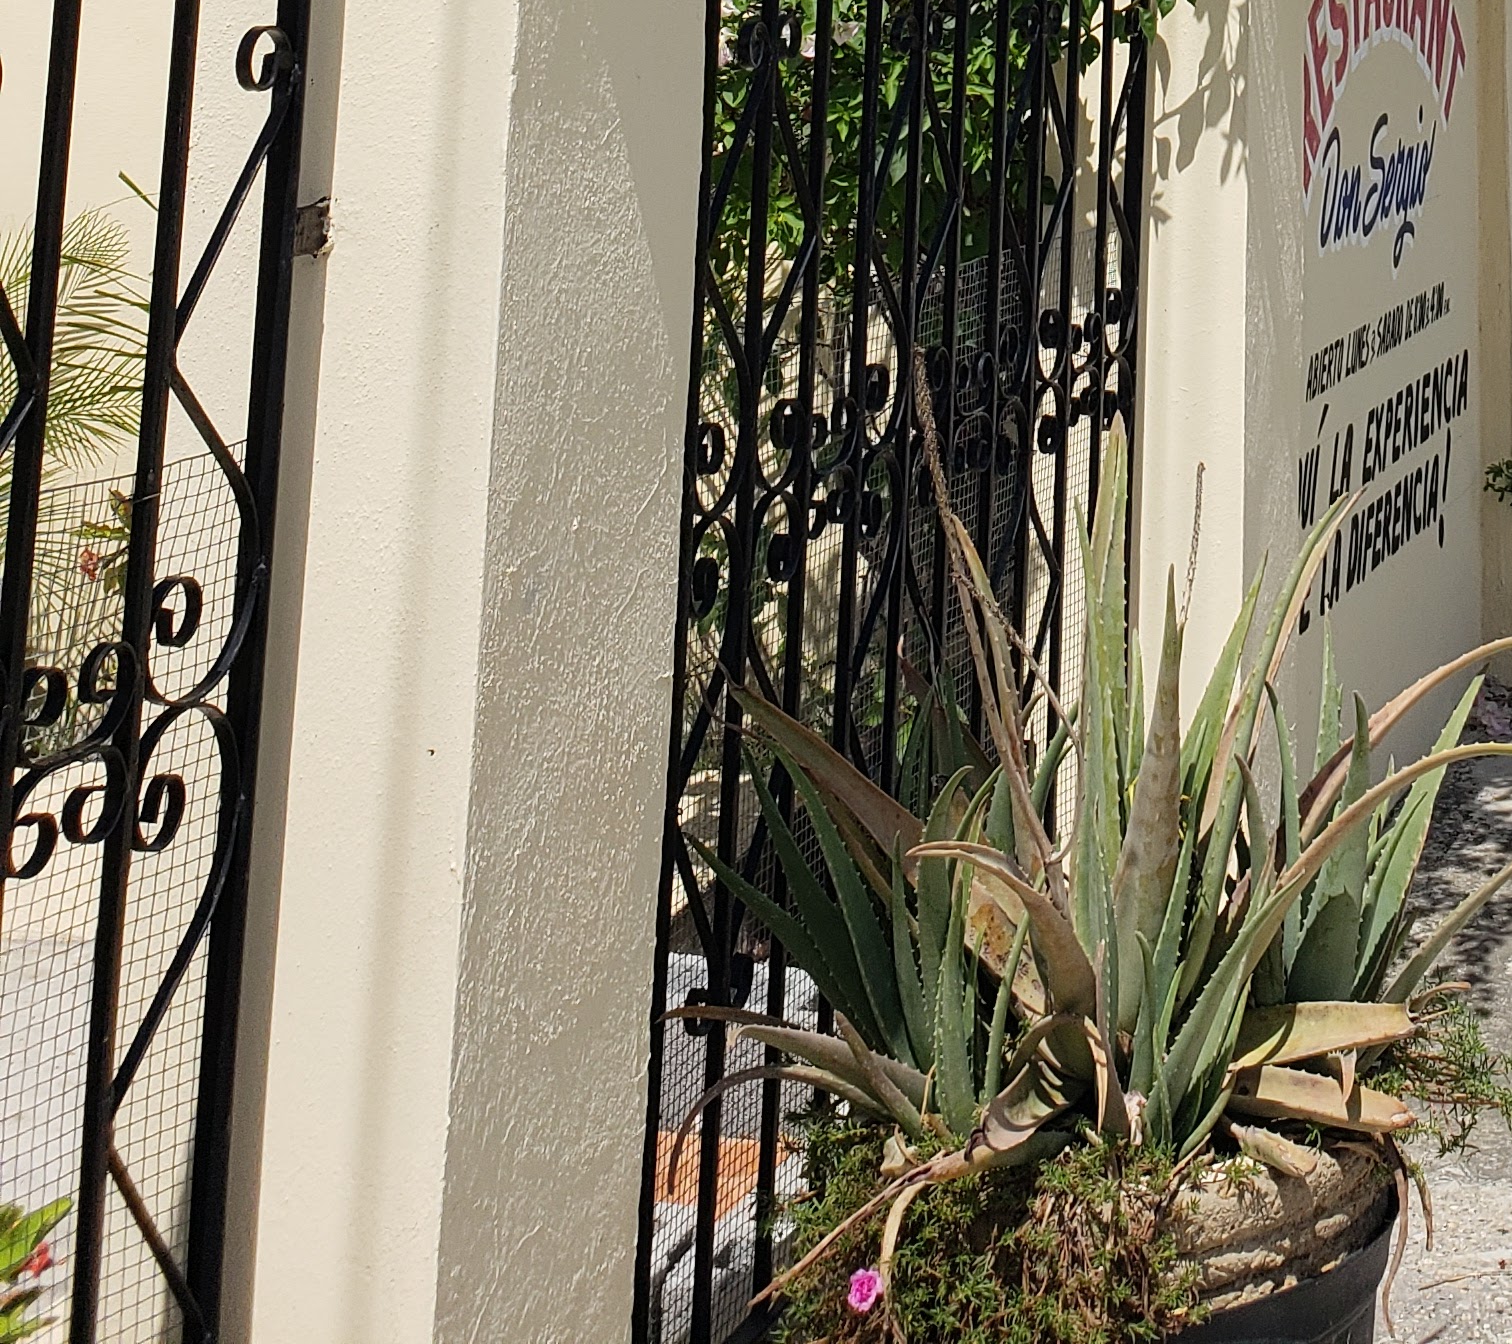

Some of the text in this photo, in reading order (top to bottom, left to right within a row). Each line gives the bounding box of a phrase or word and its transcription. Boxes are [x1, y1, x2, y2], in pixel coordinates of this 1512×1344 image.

[1321, 104, 1437, 269] Don Sergio
[1305, 337, 1345, 403] ABIERTO
[1344, 322, 1371, 378] LUNES
[1329, 423, 1354, 508] LA
[1362, 349, 1469, 486] EXPERIENCIA
[1346, 427, 1452, 593] DIFERENCIA!
